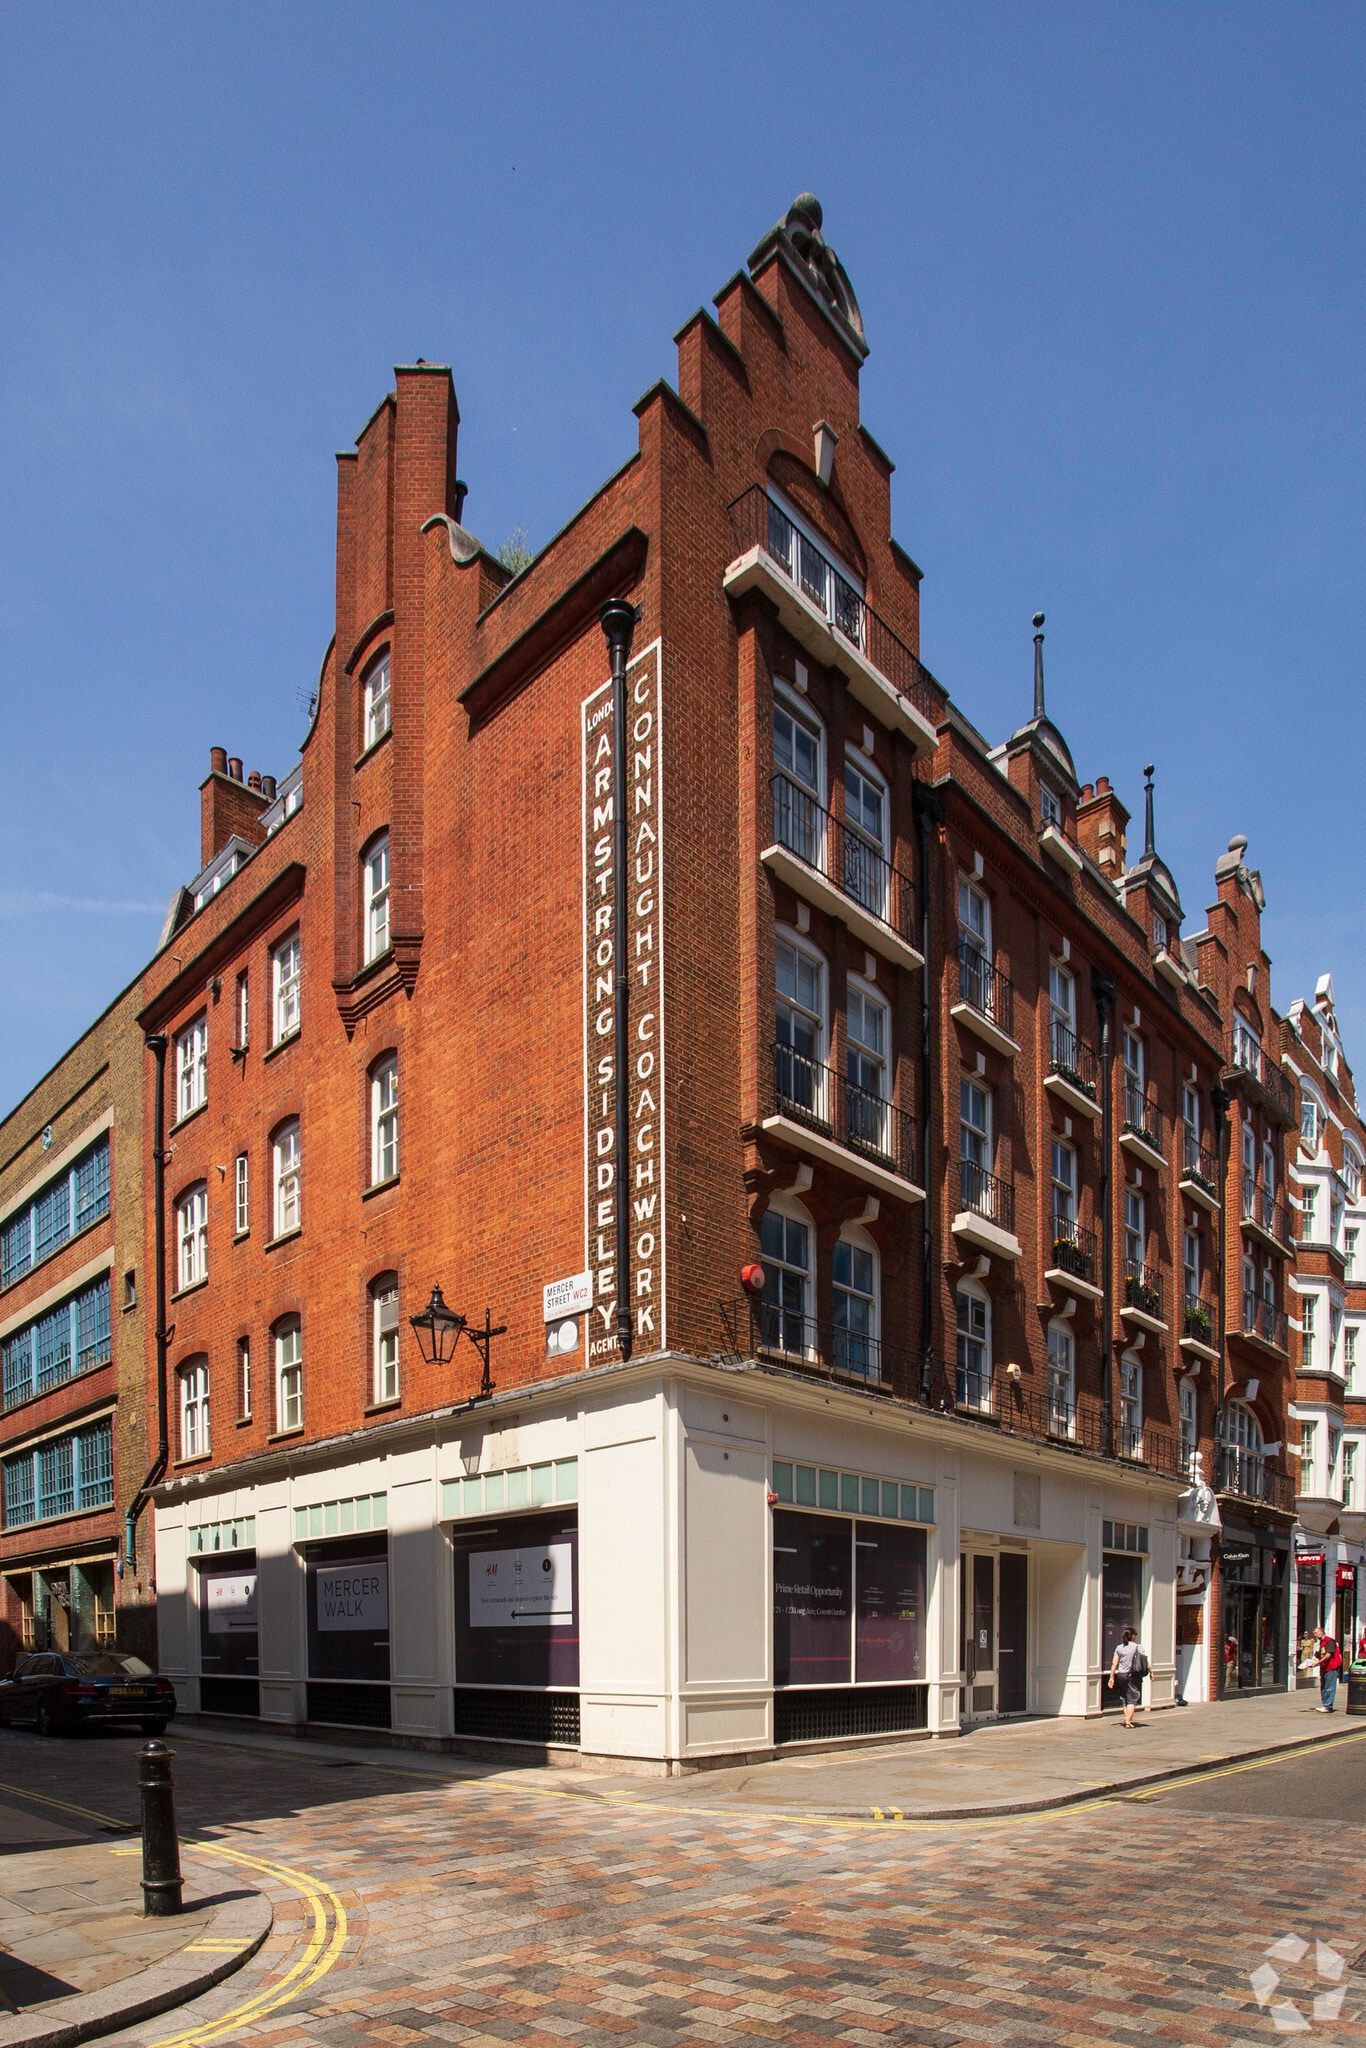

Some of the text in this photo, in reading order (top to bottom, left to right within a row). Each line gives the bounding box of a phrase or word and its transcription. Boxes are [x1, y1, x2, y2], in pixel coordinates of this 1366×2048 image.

[633, 673, 657, 1335] CONNAUGHT COACHWORK
[593, 734, 617, 1330] ARMSTRONG SIDDELEY
[546, 1280, 574, 1297] MERCER
[547, 1287, 588, 1309] STREET WC2
[324, 1577, 380, 1597] MERCER
[775, 1582, 843, 1599] Prime Retail Opportunity
[324, 1600, 364, 1617] WALK
